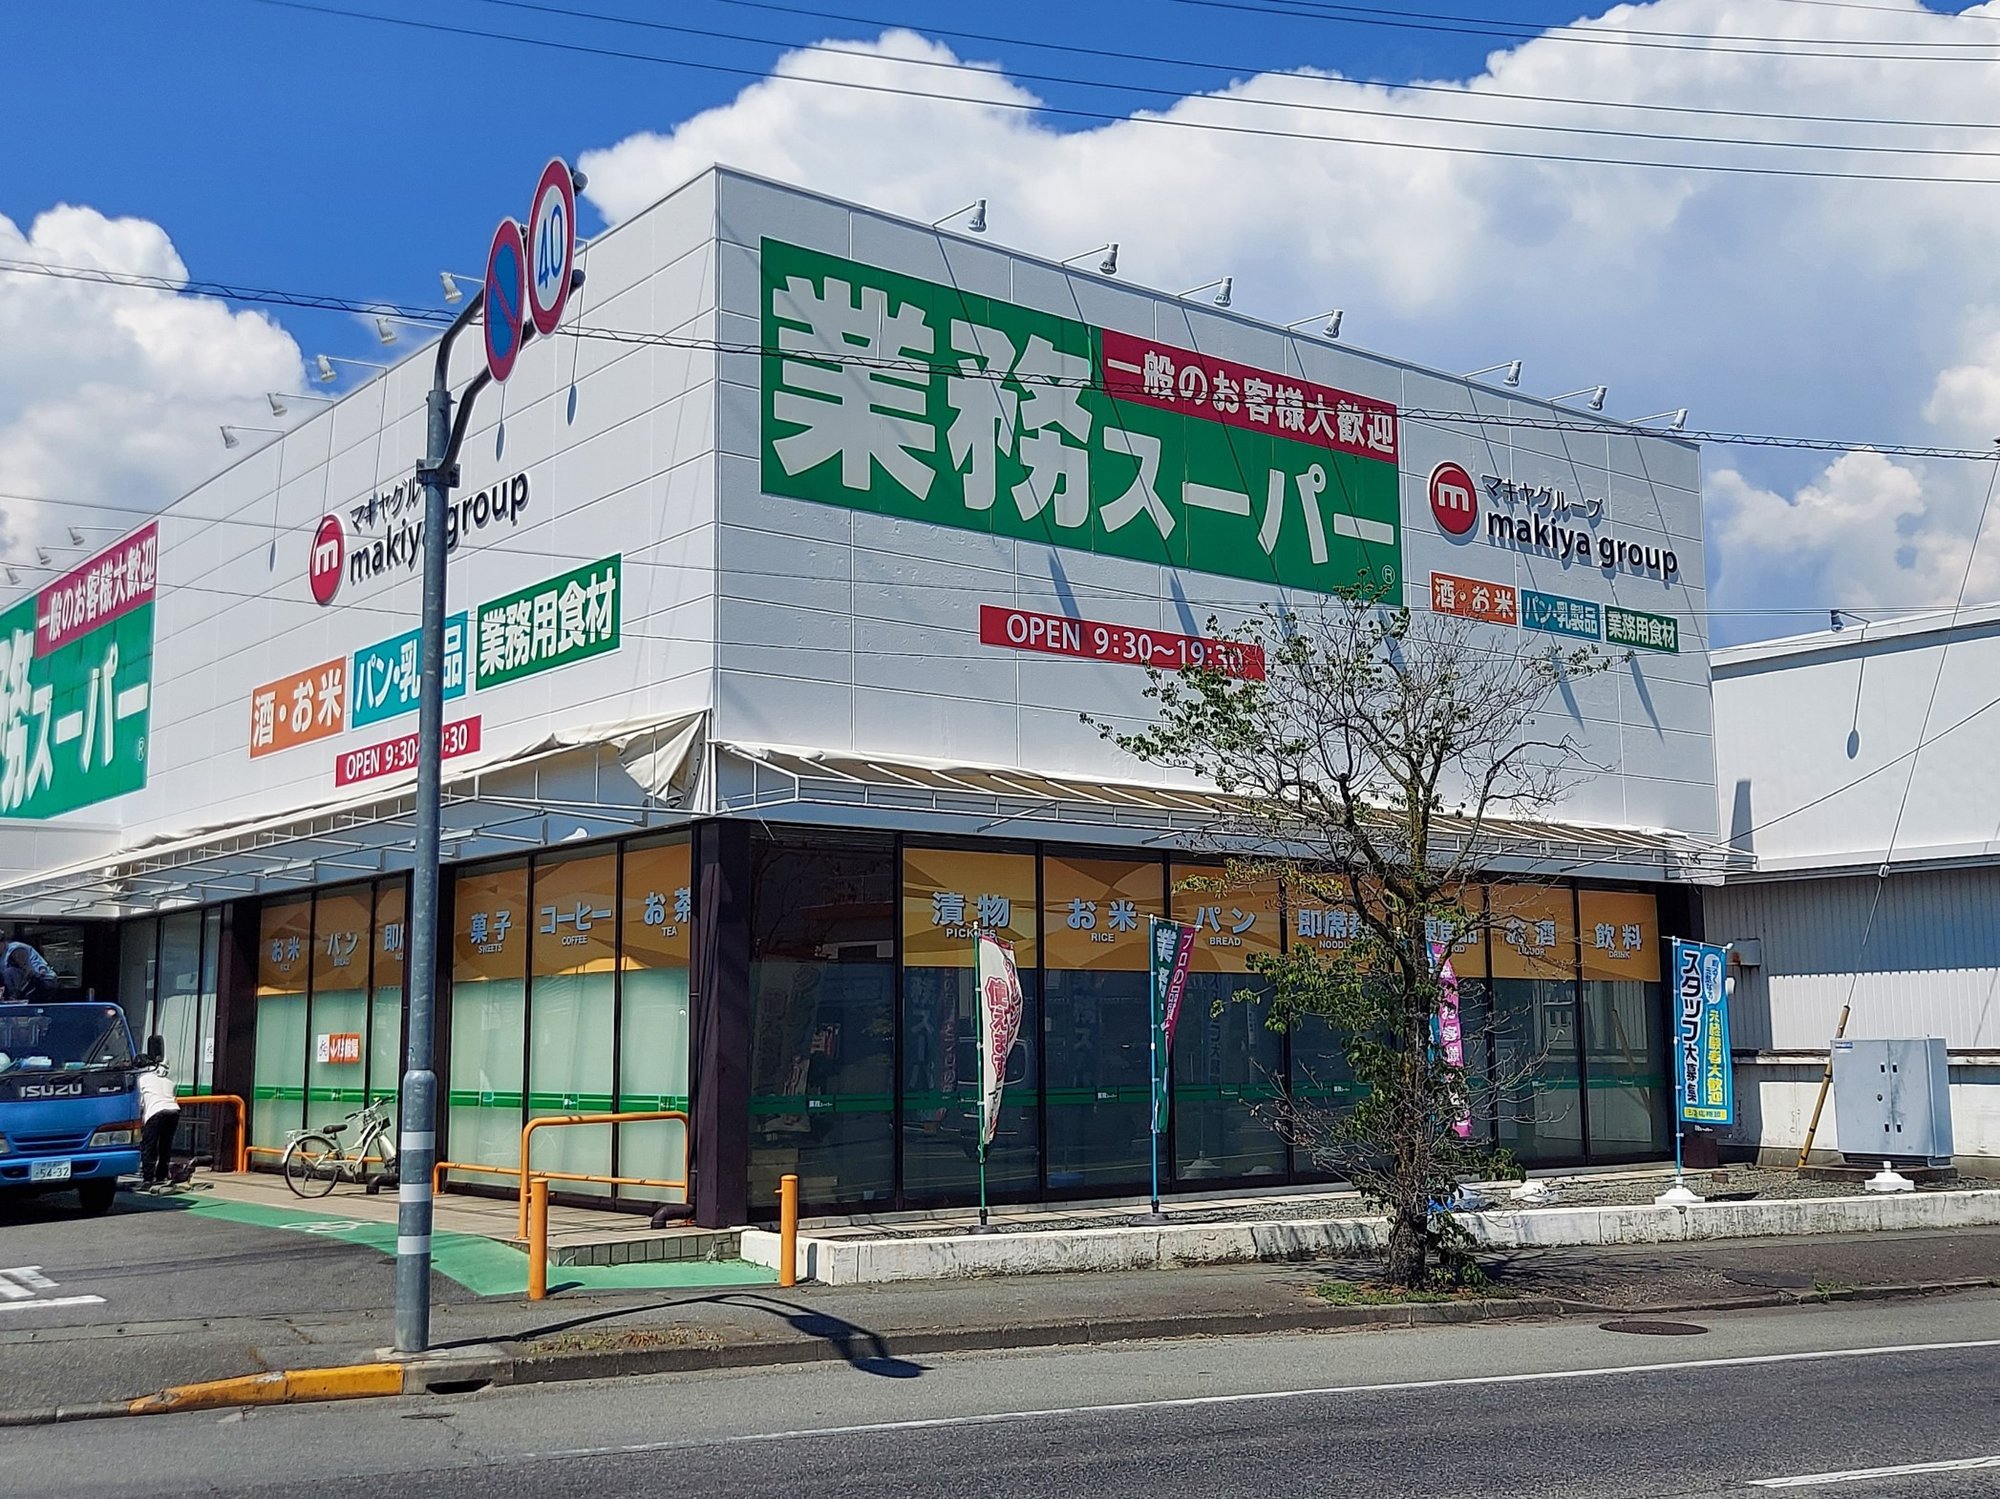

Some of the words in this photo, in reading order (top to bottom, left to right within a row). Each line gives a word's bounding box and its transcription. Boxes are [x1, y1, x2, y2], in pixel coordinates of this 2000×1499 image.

[539, 204, 563, 289] 40
[773, 276, 1395, 564] 業務スーパー
[1108, 350, 1394, 453] 一般のお客様大歓迎
[350, 476, 425, 530] マキヤグル
[1482, 474, 1602, 518] マキヤグループ
[350, 518, 425, 582] makiy
[1487, 512, 1590, 558] makiya
[1600, 536, 1678, 580] group
[38, 535, 156, 643] 一般のお客様大歓迎
[1434, 577, 1514, 618] 酒・お米
[479, 567, 616, 678] 業務用食材
[1006, 614, 1081, 651] OPEN
[1524, 596, 1599, 634] パン・乳製品
[1607, 611, 1677, 649] 業務用食材
[356, 624, 463, 713] パン・乳品
[253, 665, 343, 749] 酒・お米
[346, 747, 380, 780] OPEN
[470, 910, 512, 945] 菓子
[540, 902, 613, 935] コーヒー
[931, 891, 1011, 928] 漬物
[1066, 898, 1138, 932] お米
[1195, 906, 1257, 934] パン
[271, 936, 300, 963] お米
[326, 931, 359, 956] パン
[478, 943, 503, 955] SWEETS
[561, 934, 589, 946] COFFEE
[661, 926, 678, 937] TEA
[1090, 932, 1115, 942] RICE
[1209, 936, 1242, 947] BREAD
[1319, 940, 1351, 949] NOODL
[1595, 922, 1642, 951] 飲料
[20, 1083, 83, 1098] ISUZU
